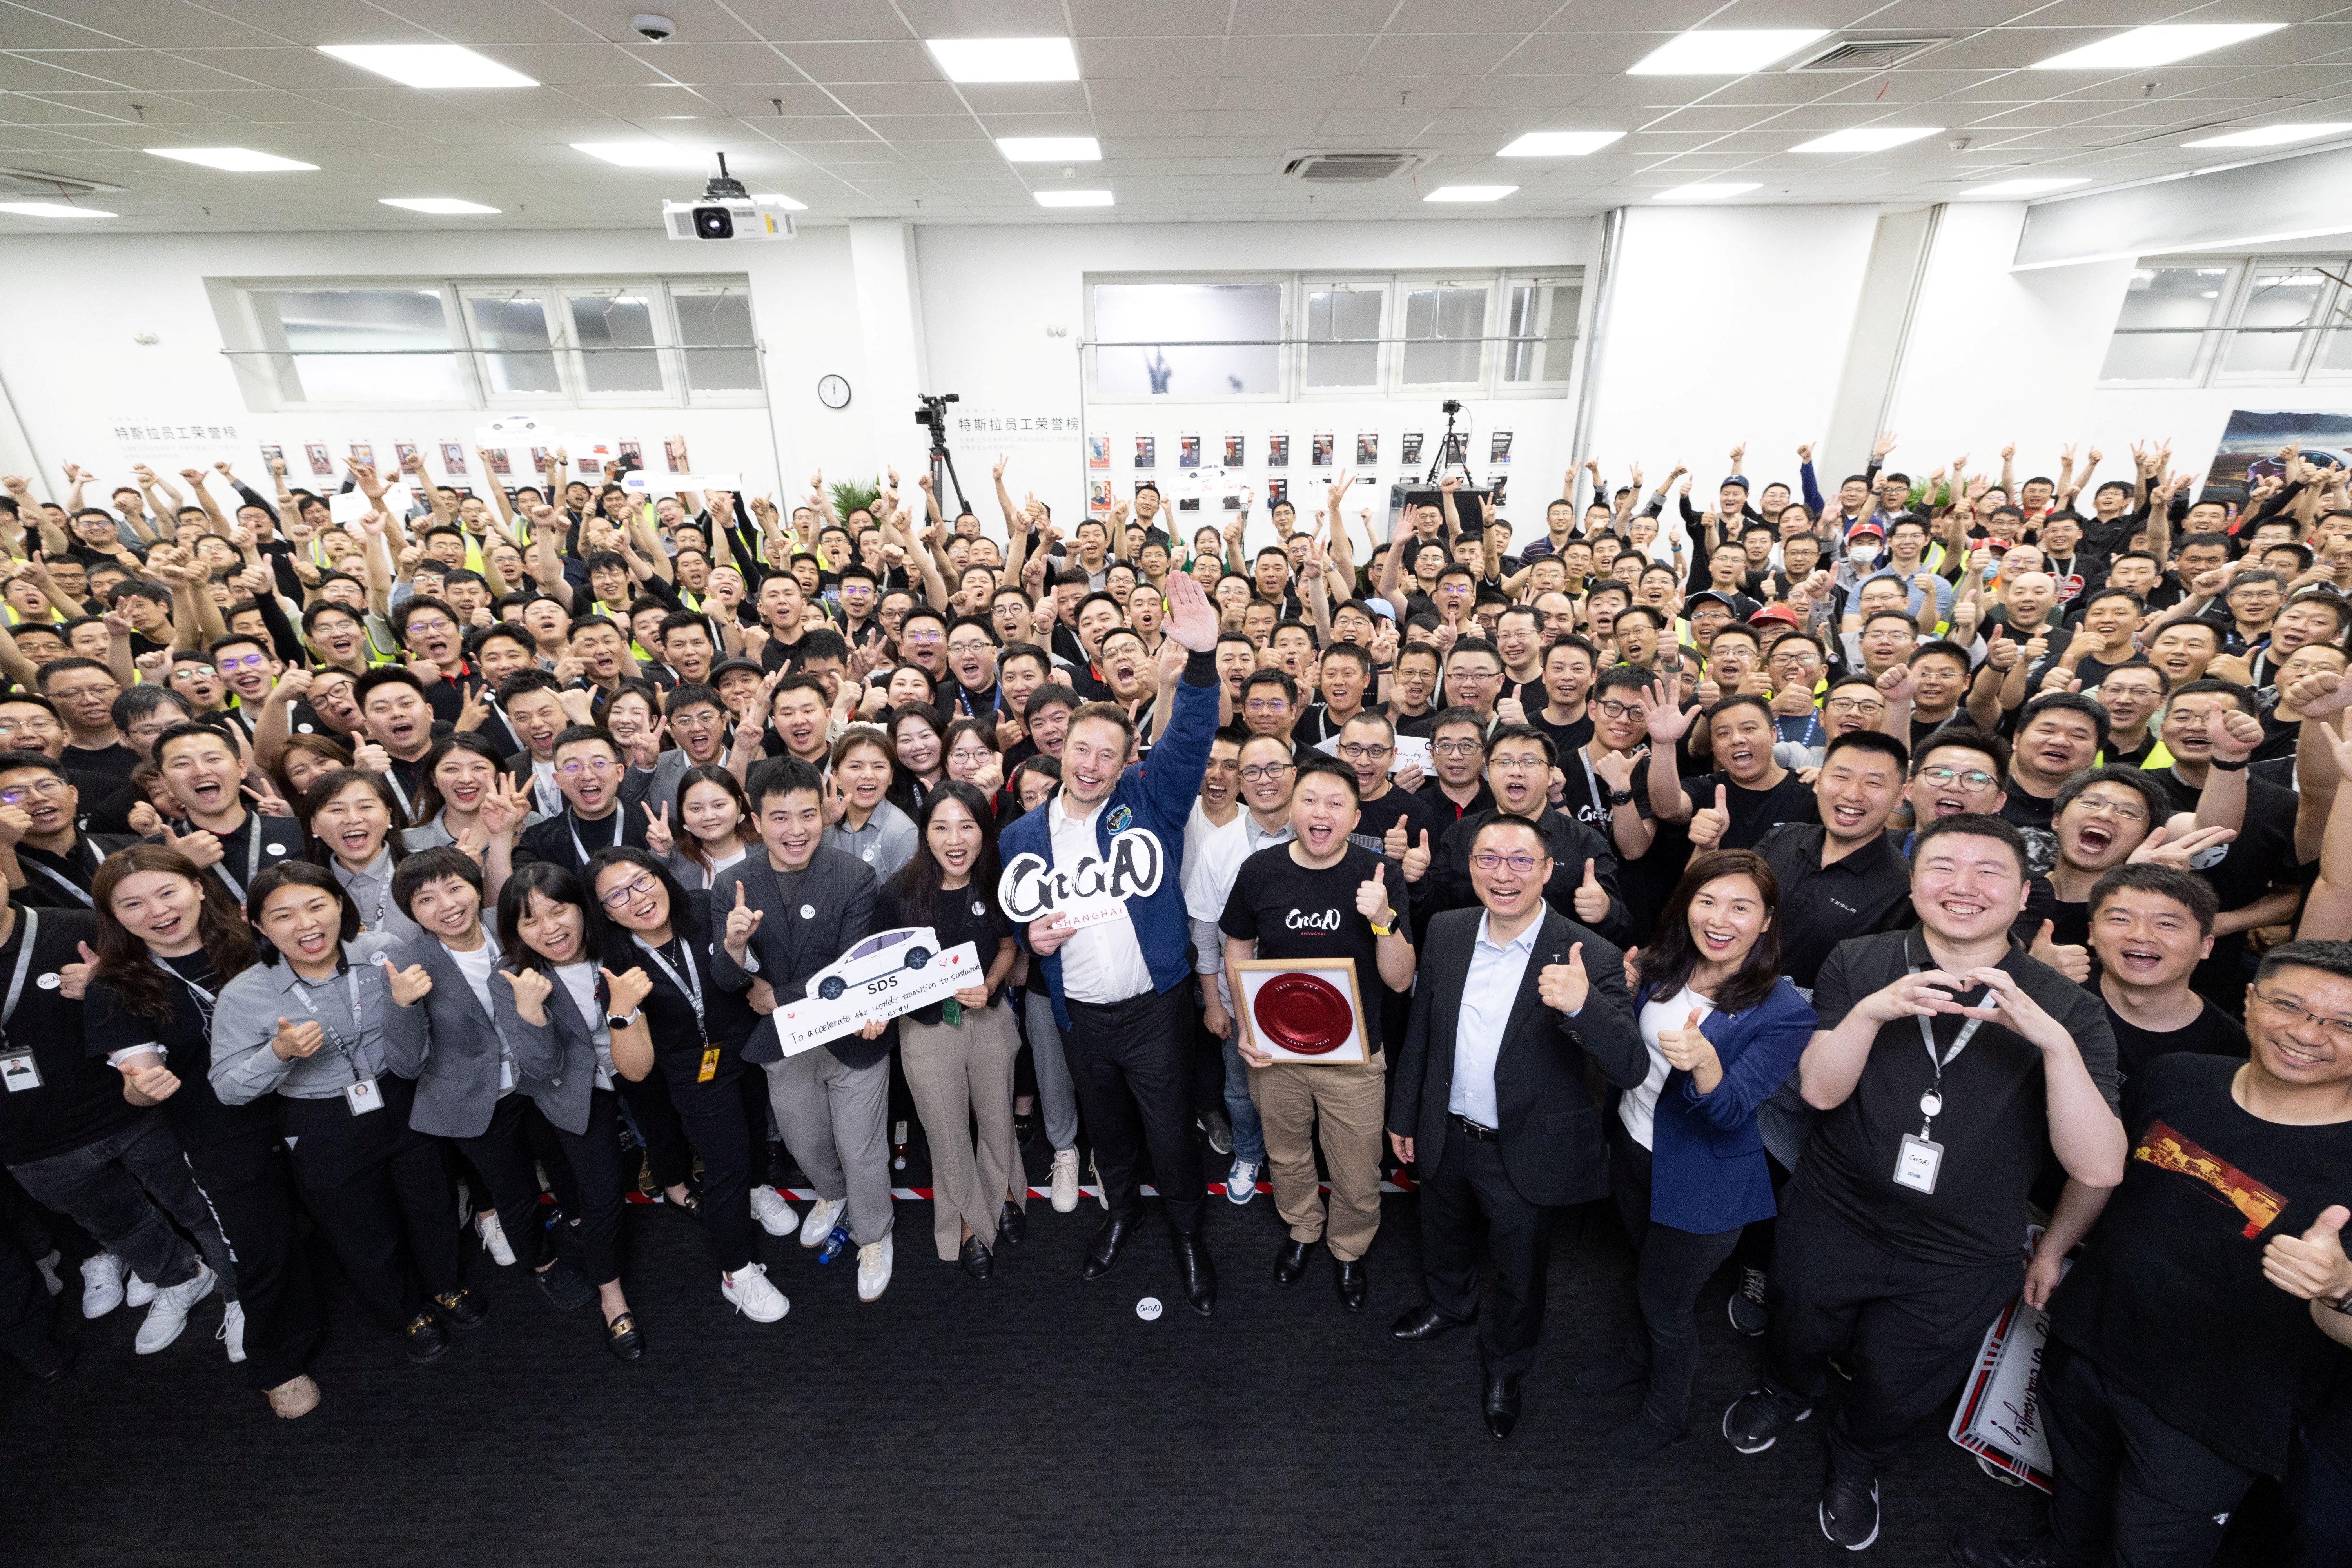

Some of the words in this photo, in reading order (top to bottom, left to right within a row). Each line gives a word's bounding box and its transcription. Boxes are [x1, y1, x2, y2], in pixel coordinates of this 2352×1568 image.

[958, 417, 1079, 432] 特斯拉员工荣誉榜
[114, 426, 238, 441] 特斯拉员工荣誉榜
[1830, 897, 1857, 913] TESLA
[1056, 906, 1122, 928] SHANGHAI
[867, 976, 898, 995] SDS
[1276, 983, 1290, 992] 2023
[788, 1032, 804, 1044] To
[855, 1010, 869, 1019] the
[902, 983, 936, 1000] transition
[939, 977, 949, 985] to
[326, 1025, 348, 1056] TESLA
[1316, 1038, 1331, 1046] CHINA
[1945, 1024, 1978, 1061] TESLA
